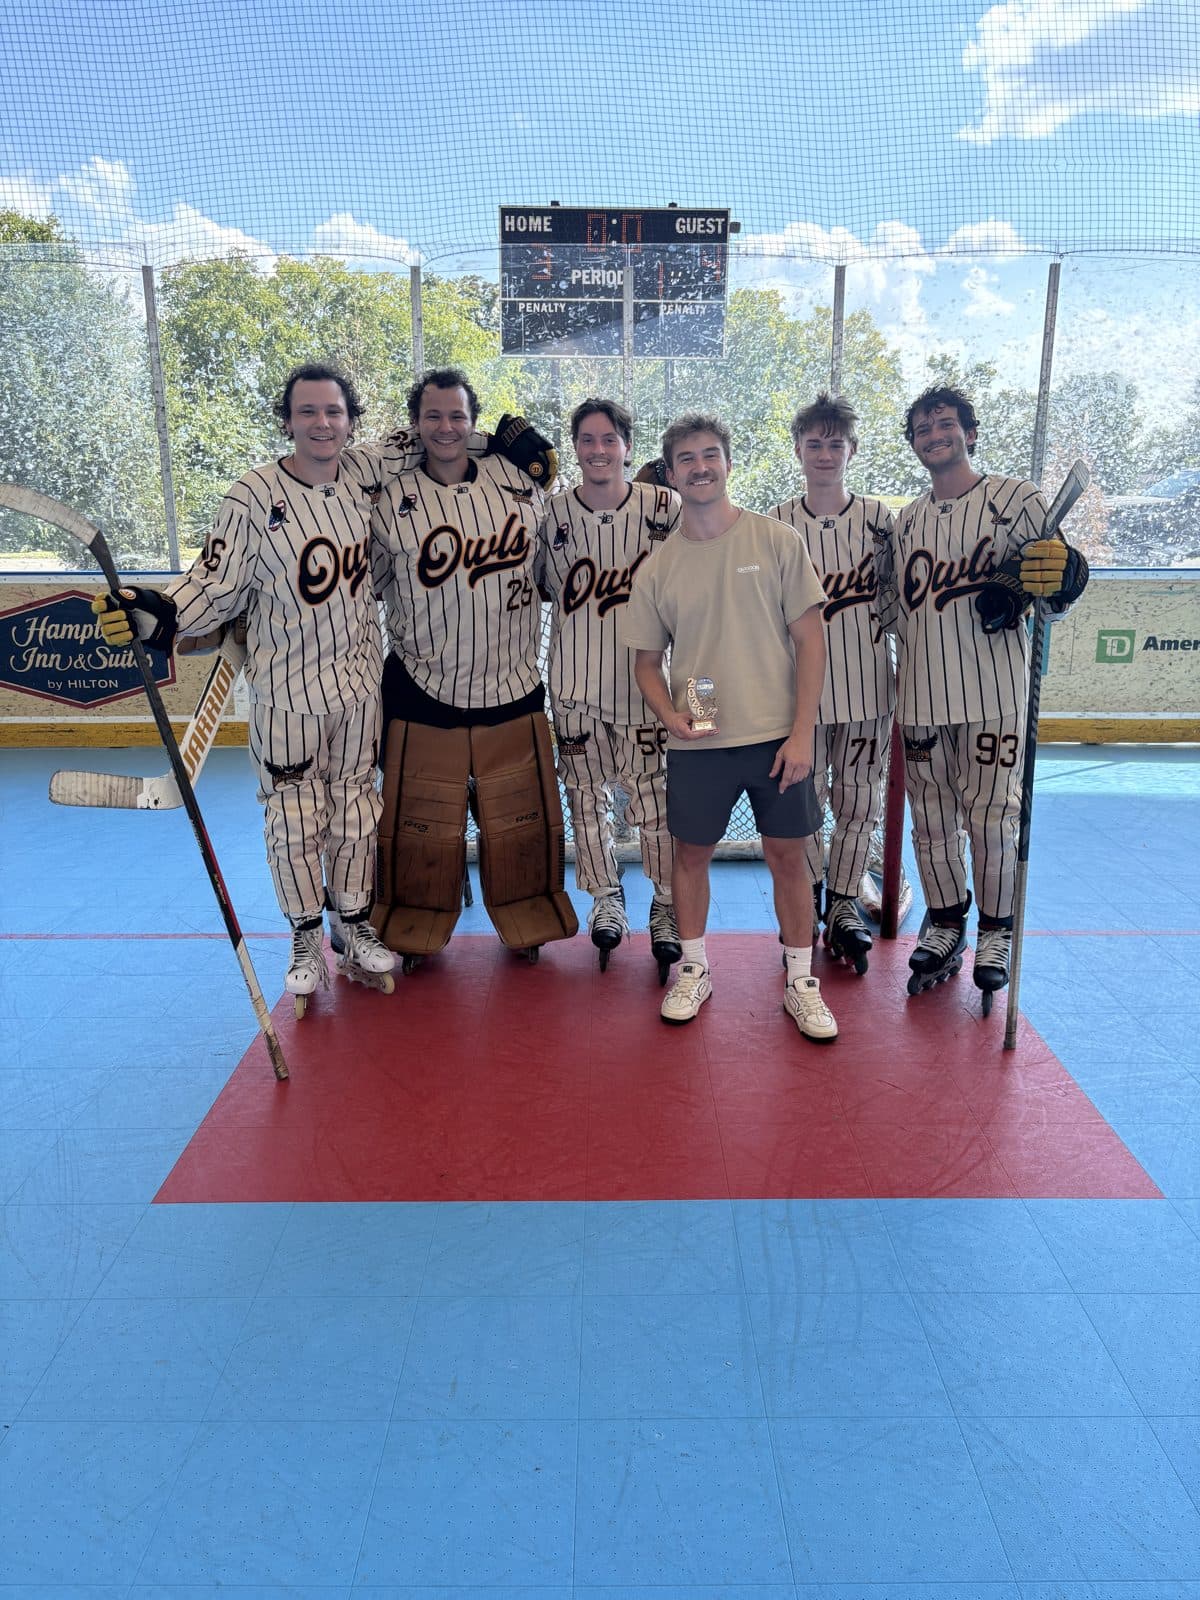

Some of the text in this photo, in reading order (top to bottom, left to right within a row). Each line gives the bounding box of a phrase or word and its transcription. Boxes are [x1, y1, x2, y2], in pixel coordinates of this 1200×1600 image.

[504, 215, 553, 232] HOME
[675, 217, 725, 234] GUEST
[518, 302, 566, 313] PENALTY
[660, 304, 707, 316] PENALTY
[656, 491, 669, 514] A
[417, 512, 531, 590] Owls
[298, 535, 369, 606] Ow
[563, 550, 649, 618] Owl
[812, 552, 880, 623] wls
[11, 615, 104, 647] Hampt
[9, 645, 154, 673] Inn & Suits
[1101, 635, 1131, 657] TD
[47, 679, 119, 691] by HILTON
[687, 677, 705, 717] 2026
[849, 737, 878, 767] 71
[975, 732, 1019, 768] 93
